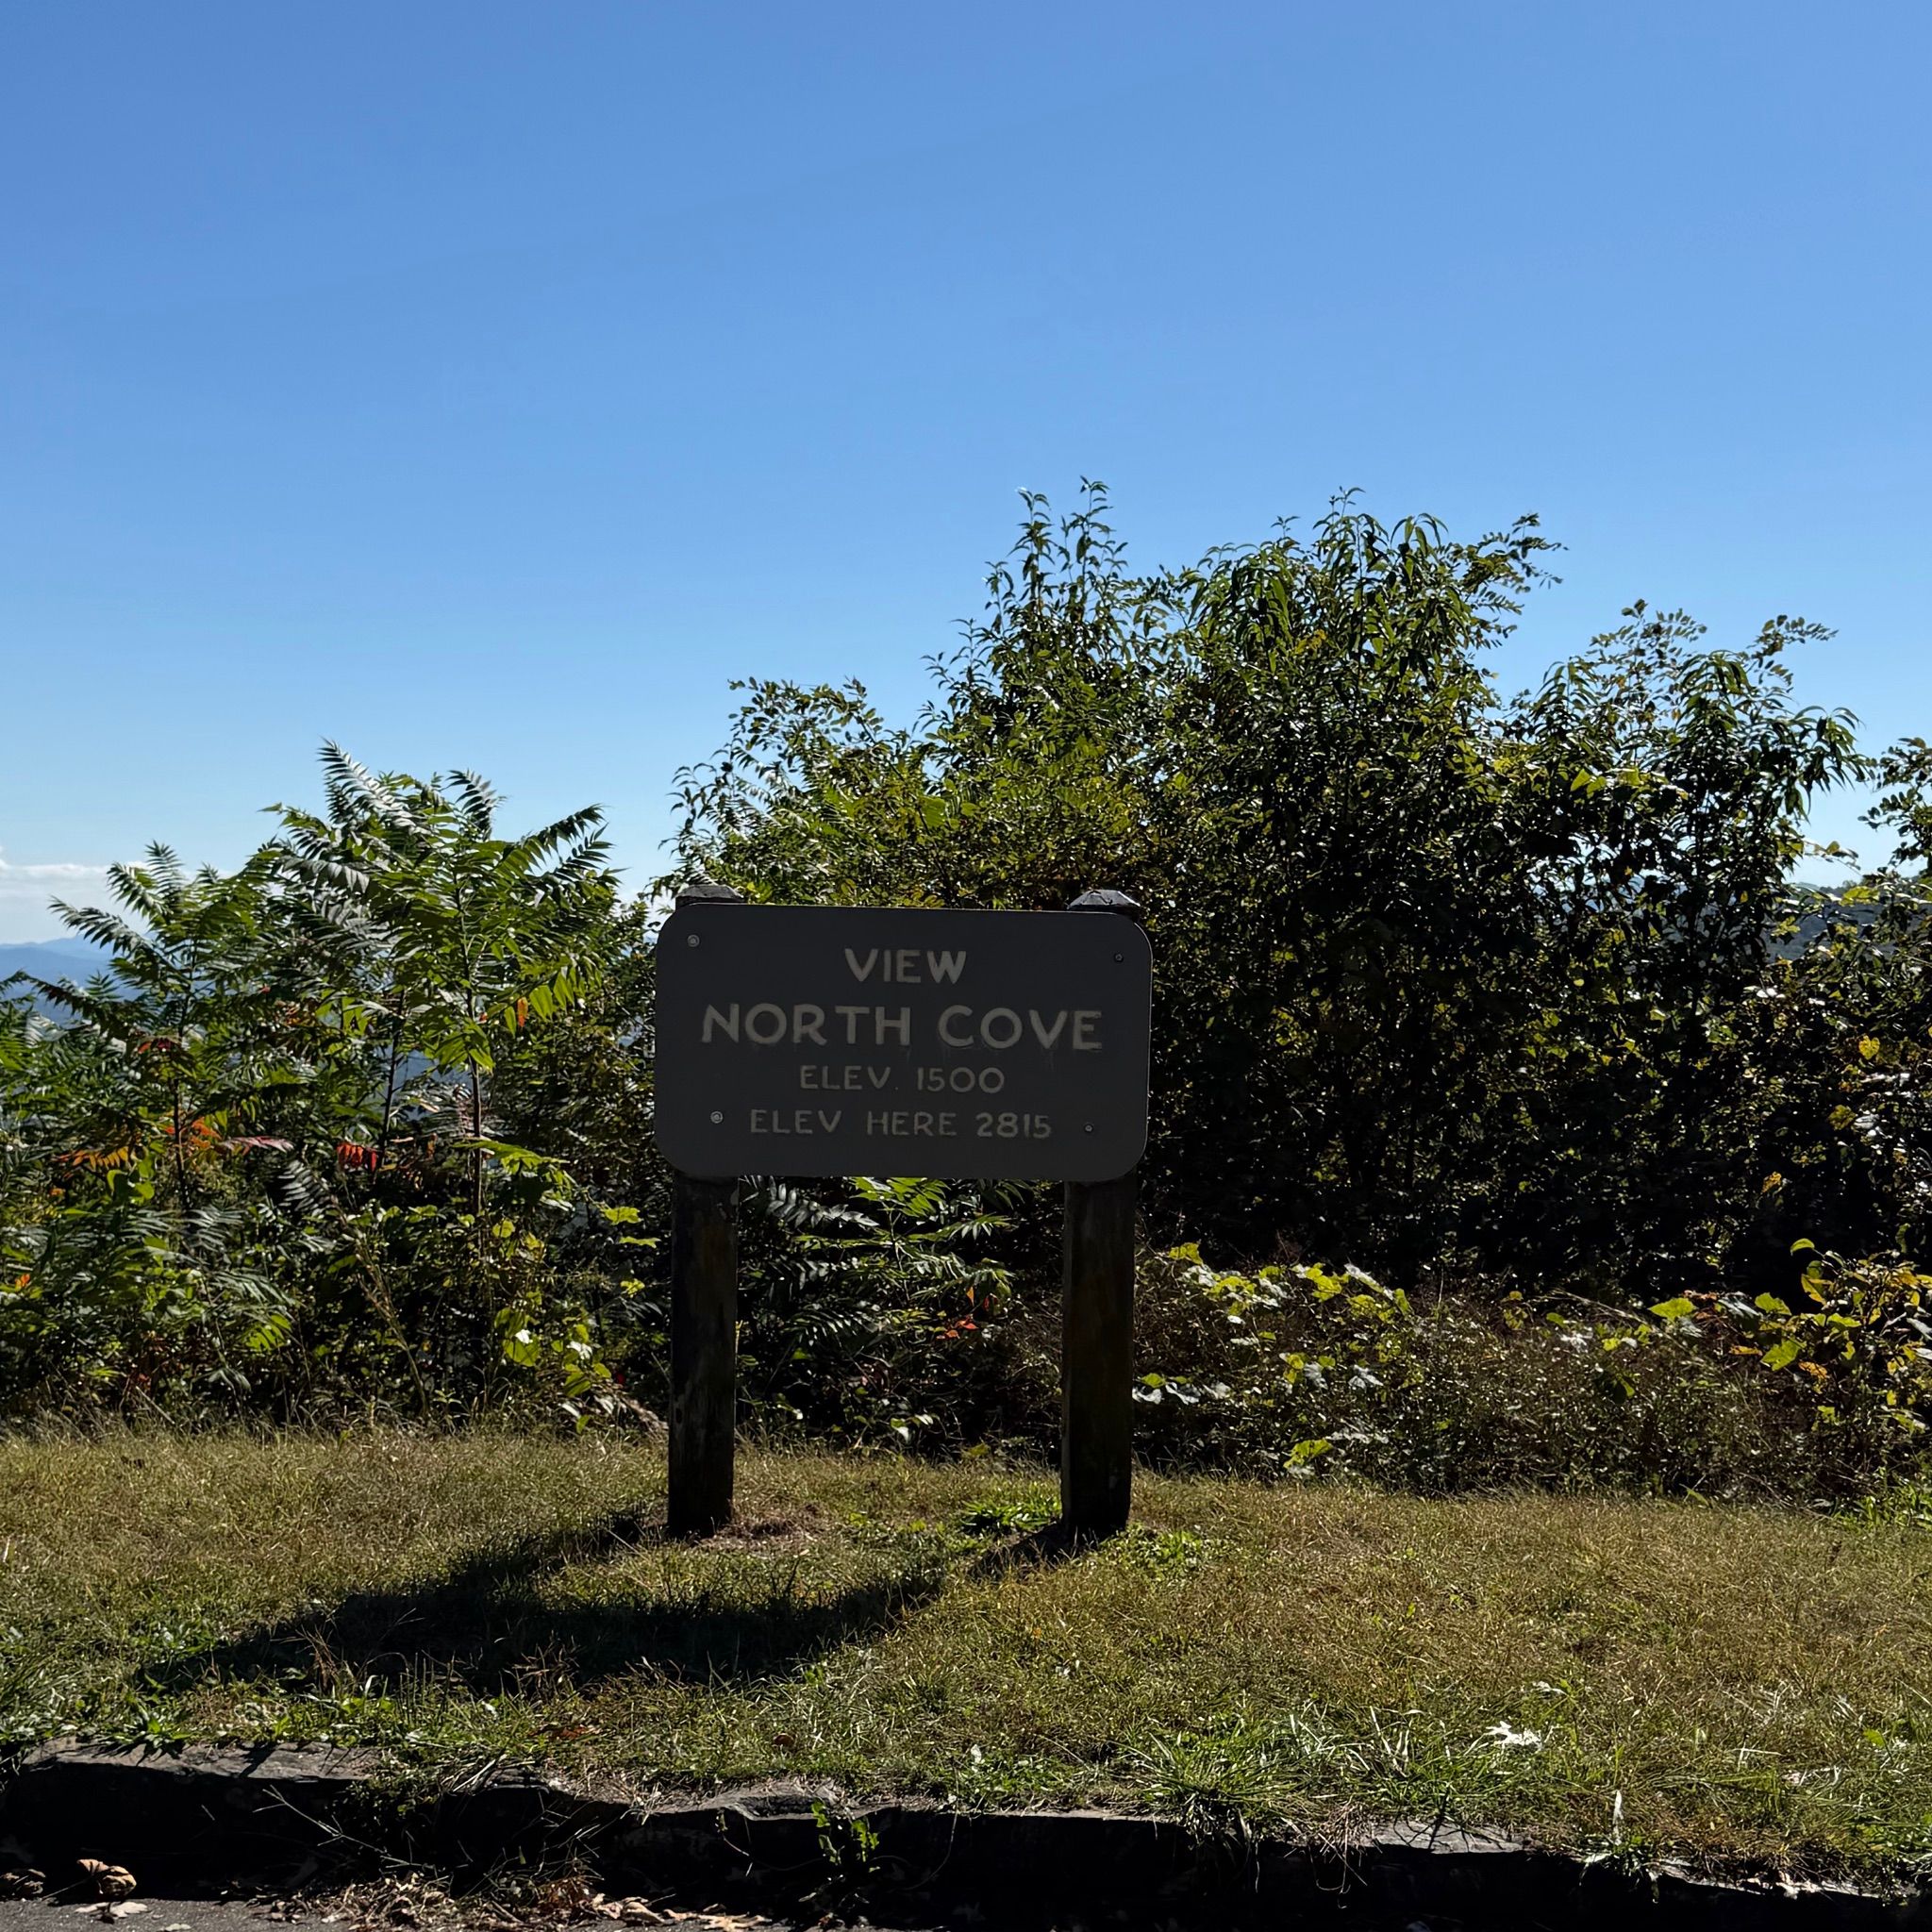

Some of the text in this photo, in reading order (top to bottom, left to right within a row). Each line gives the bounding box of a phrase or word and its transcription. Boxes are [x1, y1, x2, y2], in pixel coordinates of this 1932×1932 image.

[844, 948, 967, 984] VIEW
[701, 1002, 1102, 1050] NORTH COVE
[917, 1066, 1006, 1093] 1500
[750, 1108, 1052, 1139] ELEV HERE 2815
